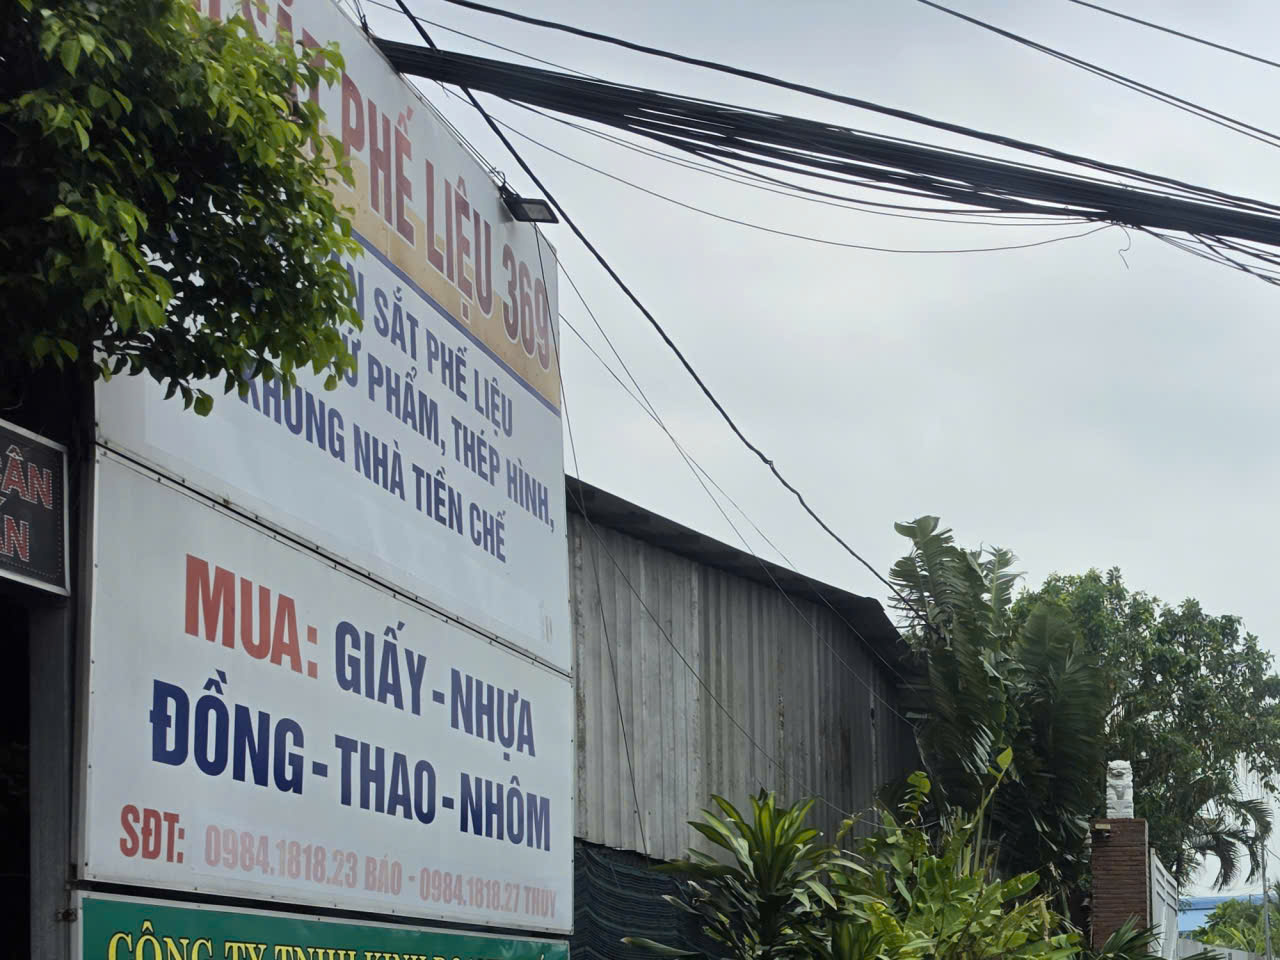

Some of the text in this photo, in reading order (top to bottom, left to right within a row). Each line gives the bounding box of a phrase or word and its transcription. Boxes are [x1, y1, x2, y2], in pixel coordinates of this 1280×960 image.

[341, 72, 415, 248] PHẾ
[425, 158, 492, 322] LIỆU
[502, 242, 551, 372] 369
[374, 286, 419, 362] SẮT
[426, 327, 468, 403] PHẾ
[474, 375, 513, 438] LIỆU
[353, 422, 406, 502] NHÀ
[412, 463, 464, 537] TIỀN
[469, 501, 506, 564] CHẾ
[367, 352, 447, 457] PHẨM,
[451, 415, 501, 487] THÉP
[506, 457, 555, 533] HÌNH,
[185, 553, 319, 680] MUA:
[119, 803, 185, 865] SĐT:
[204, 824, 358, 890] 0984.1818.23
[364, 854, 402, 896] BÁO
[419, 867, 521, 914] 0984.1818.27
